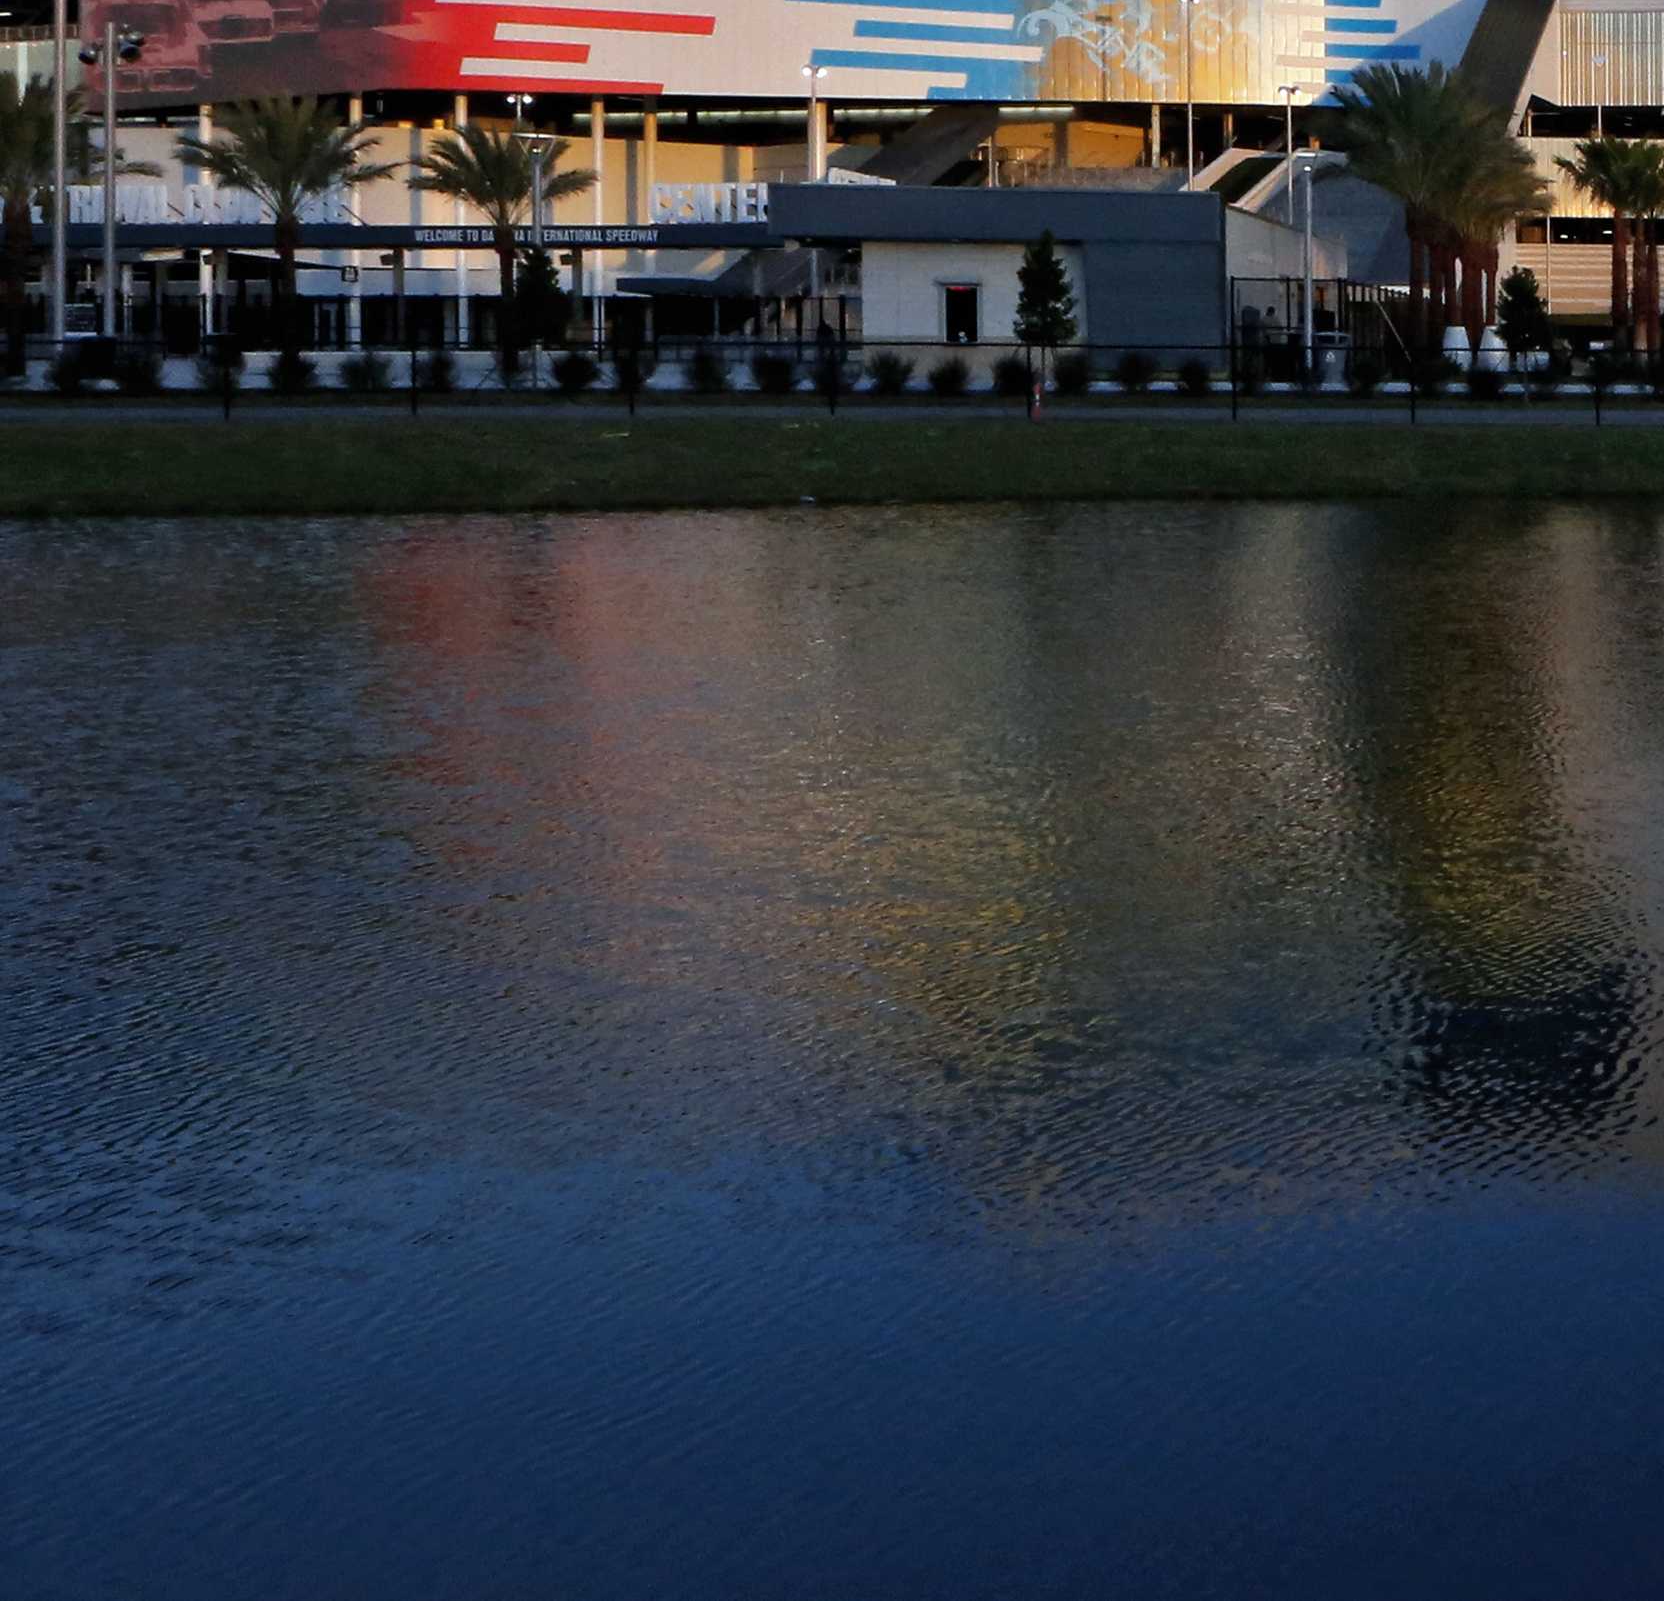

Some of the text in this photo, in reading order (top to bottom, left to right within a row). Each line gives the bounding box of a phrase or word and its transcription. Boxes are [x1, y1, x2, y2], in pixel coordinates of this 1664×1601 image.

[414, 229, 464, 242] WELCOME
[466, 229, 480, 242] TO
[528, 229, 602, 242] IERNATIONAL
[606, 229, 659, 242] SPEEDWAY
